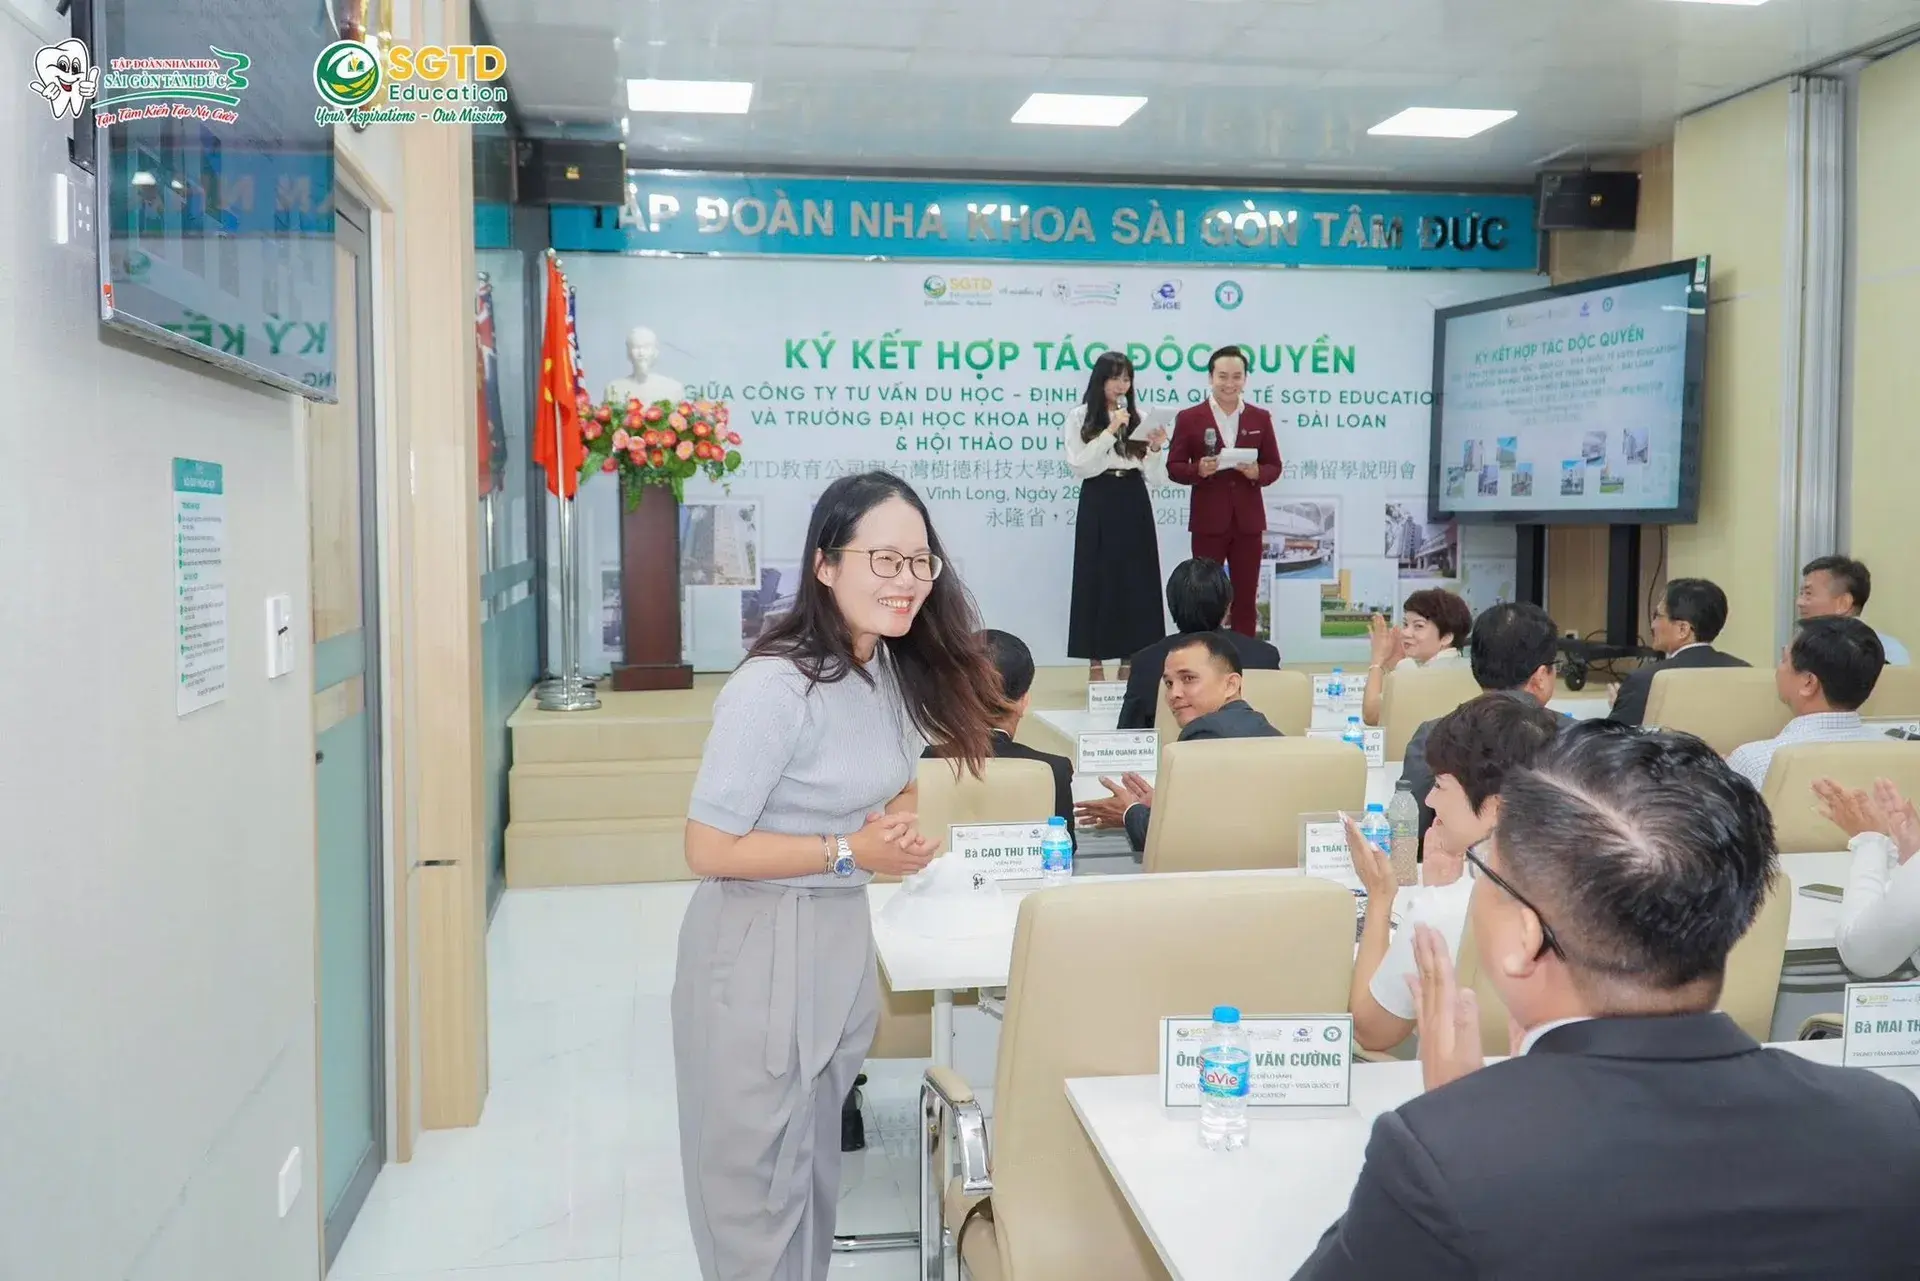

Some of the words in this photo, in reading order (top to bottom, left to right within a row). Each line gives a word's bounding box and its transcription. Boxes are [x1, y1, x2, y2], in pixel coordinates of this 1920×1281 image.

[696, 190, 834, 236] ĐOÀN
[850, 201, 947, 240] NHA
[966, 202, 1096, 243] KHOA
[1112, 199, 1186, 245] SÀI
[1200, 199, 1298, 246] GÒN
[1314, 205, 1402, 249] TÂM
[1418, 207, 1508, 251] ĐỨC
[785, 331, 837, 369] KÝ
[852, 328, 923, 369] KẾT
[937, 338, 1020, 380] HỢP
[1033, 333, 1110, 371] TÁC
[1126, 335, 1213, 381] ĐỘC
[684, 381, 735, 401] GIỮA
[742, 381, 806, 401] CÔNG
[814, 386, 838, 401] TY
[846, 385, 871, 401] TƯ
[878, 381, 917, 401] VẤN
[926, 387, 952, 401] DU
[961, 387, 1005, 406] HỌC
[1030, 387, 1077, 406] ĐỊNH
[1136, 389, 1179, 403] VISA
[1252, 384, 1275, 403] TẾ
[1281, 388, 1332, 404] SGTD
[751, 406, 777, 425] VÀ
[786, 407, 871, 426] TRƯỜNG
[880, 411, 914, 430] ĐẠI
[922, 411, 966, 430] HỌC
[974, 412, 1030, 426] KHOA
[1037, 412, 1066, 430] HỌ
[1297, 410, 1329, 428] ĐÀI
[1337, 413, 1387, 428] LOAN
[896, 436, 908, 451] &
[916, 432, 951, 454] HỘI
[959, 431, 1014, 451] THẢO
[1022, 436, 1048, 451] DU
[926, 486, 961, 500] Vĩnh
[966, 486, 1010, 504] Long,
[1015, 486, 1058, 504] Ngày
[1062, 486, 1080, 500] 28
[964, 848, 978, 858] Bà
[981, 847, 1002, 858] CAO
[1005, 846, 1024, 857] THU
[1855, 1020, 1872, 1034] Bà
[1876, 1020, 1902, 1033] MAI
[1255, 1050, 1285, 1067] VĂN
[1290, 1049, 1341, 1067] CƯỜNG
